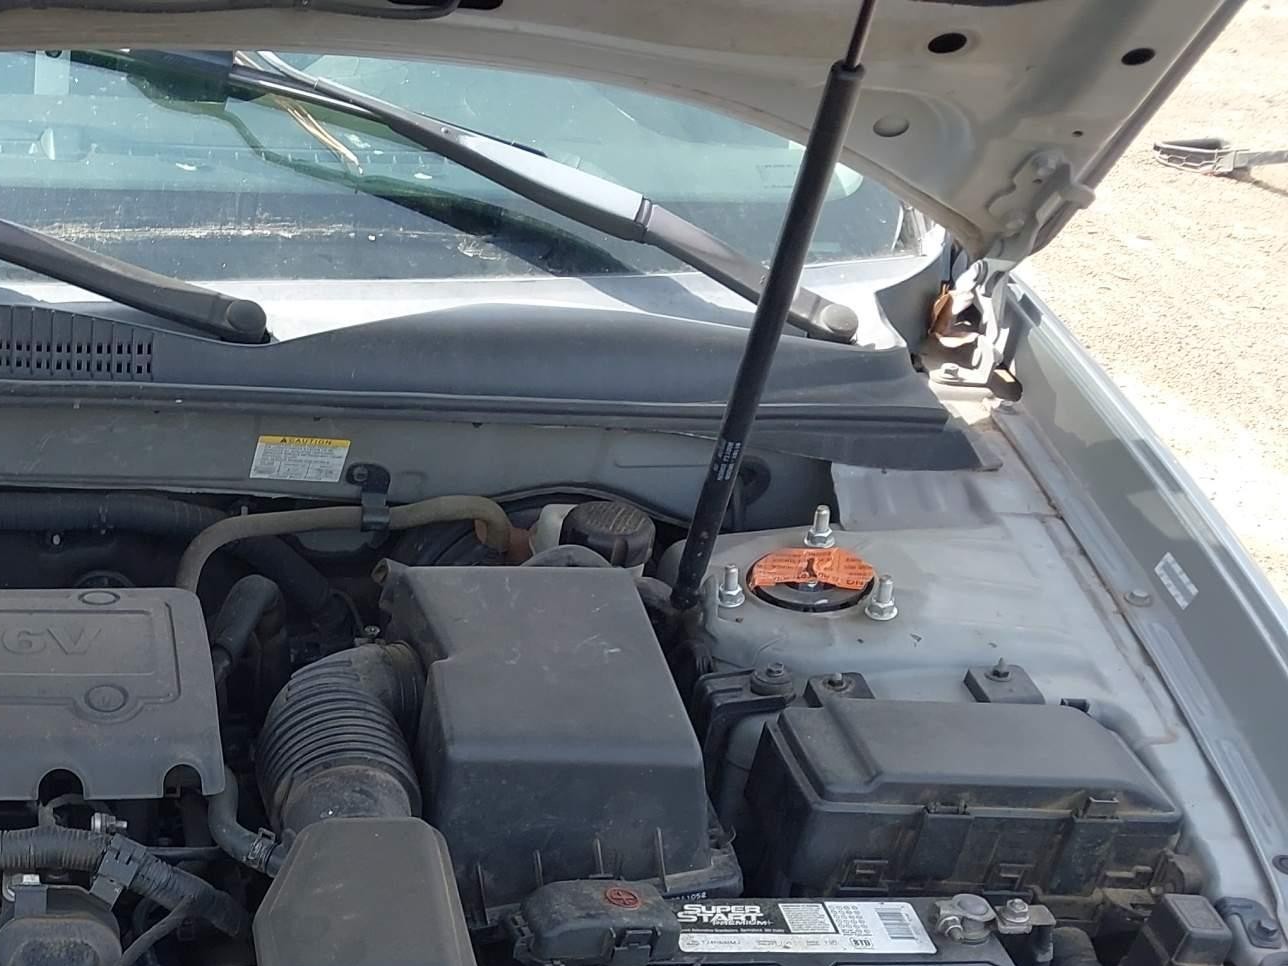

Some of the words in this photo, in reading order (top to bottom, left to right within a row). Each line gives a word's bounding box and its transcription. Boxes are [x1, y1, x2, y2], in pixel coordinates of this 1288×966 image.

[289, 437, 332, 446] CAUTION
[683, 903, 761, 914] SUPER
[677, 911, 764, 923] START
